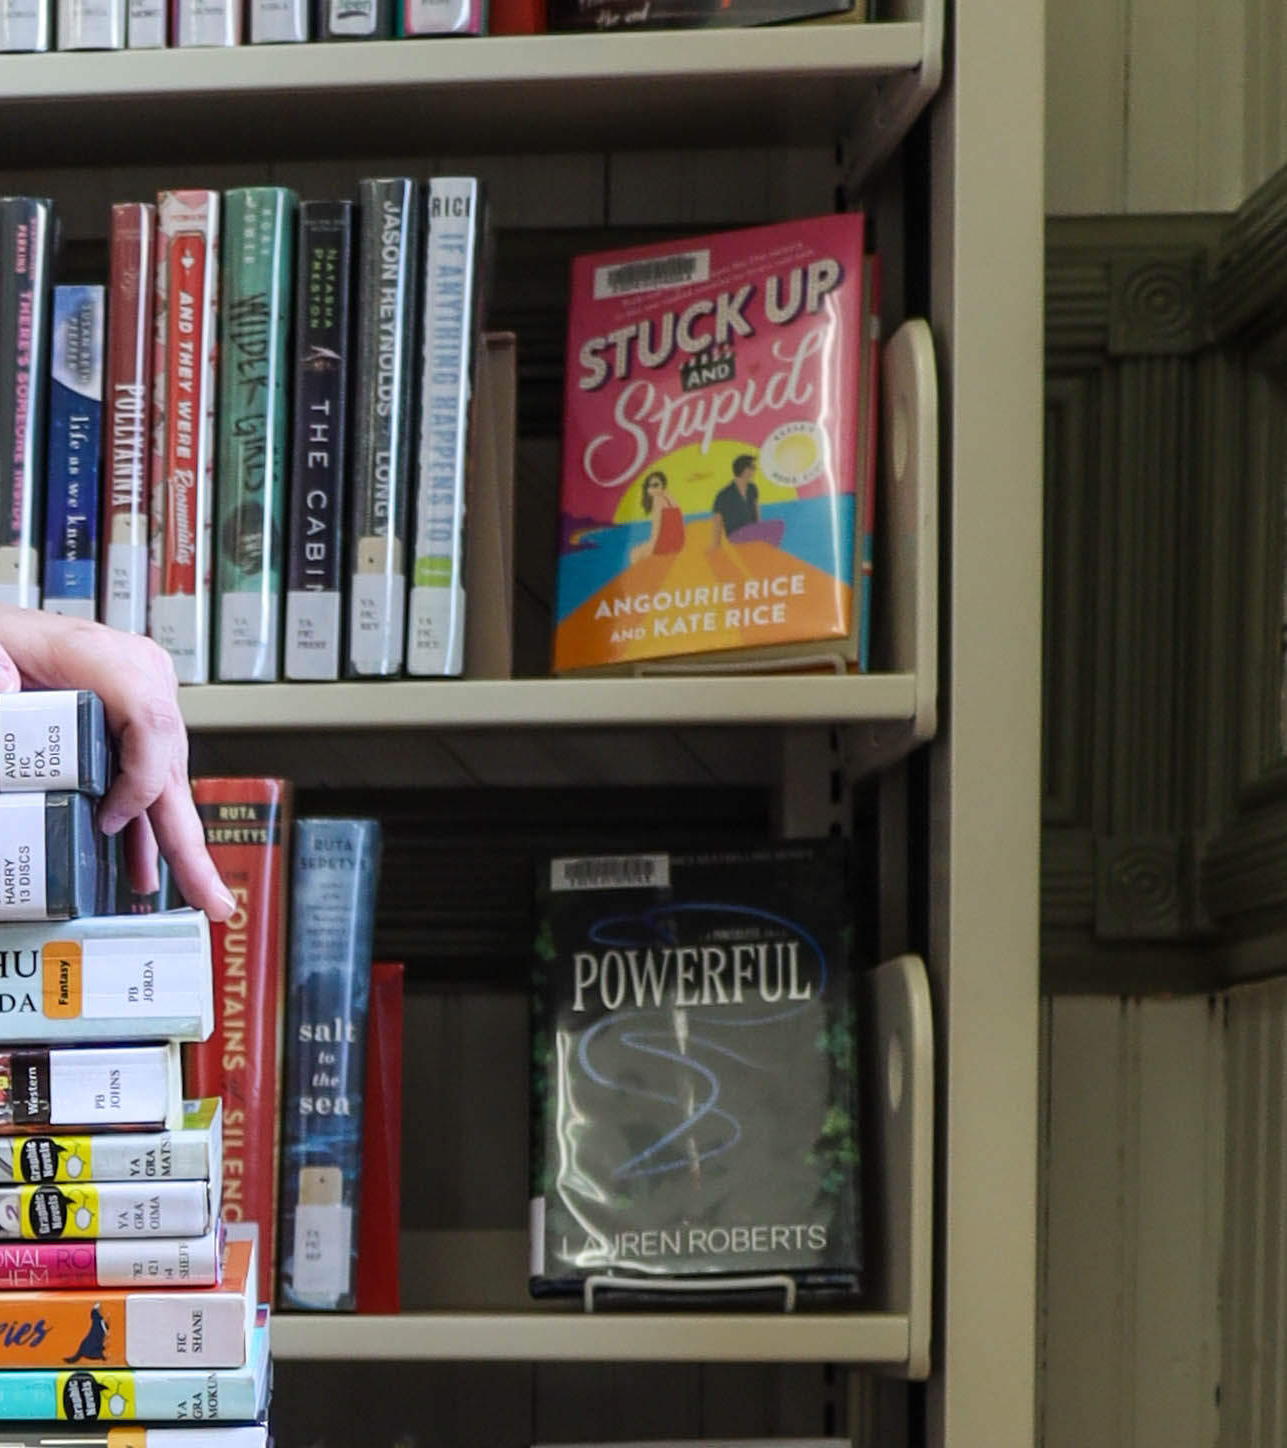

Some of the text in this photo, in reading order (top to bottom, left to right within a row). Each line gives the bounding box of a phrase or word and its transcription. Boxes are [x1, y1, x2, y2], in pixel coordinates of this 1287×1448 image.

[579, 285, 755, 391] STUCK
[764, 258, 843, 323] UP
[177, 292, 195, 457] AND THEY WERE
[687, 364, 729, 387] AND
[584, 327, 827, 487] Stupid
[309, 400, 329, 469] THE
[66, 508, 78, 560] knew
[594, 574, 806, 619] ANGOURIE RICE
[610, 602, 786, 642] AND KATE RICE
[4, 732, 16, 778] AVBCD
[20, 757, 31, 778] FIC
[49, 725, 60, 777] 9 DISCS
[218, 805, 257, 821] RUTA
[207, 826, 268, 844] SEPETYS
[5, 859, 15, 904] HARRY
[19, 846, 30, 886] DISCS
[59, 960, 71, 1005] Fantasy
[572, 941, 811, 1012] POWERFUL
[299, 1019, 357, 1043] salt
[312, 1073, 339, 1088] the
[318, 1052, 334, 1067] to
[27, 1067, 37, 1115] Western
[299, 1092, 351, 1116] sea
[689, 1224, 827, 1253] ROBERTS
[178, 1333, 187, 1352] FIC
[193, 1310, 203, 1352] SHANE
